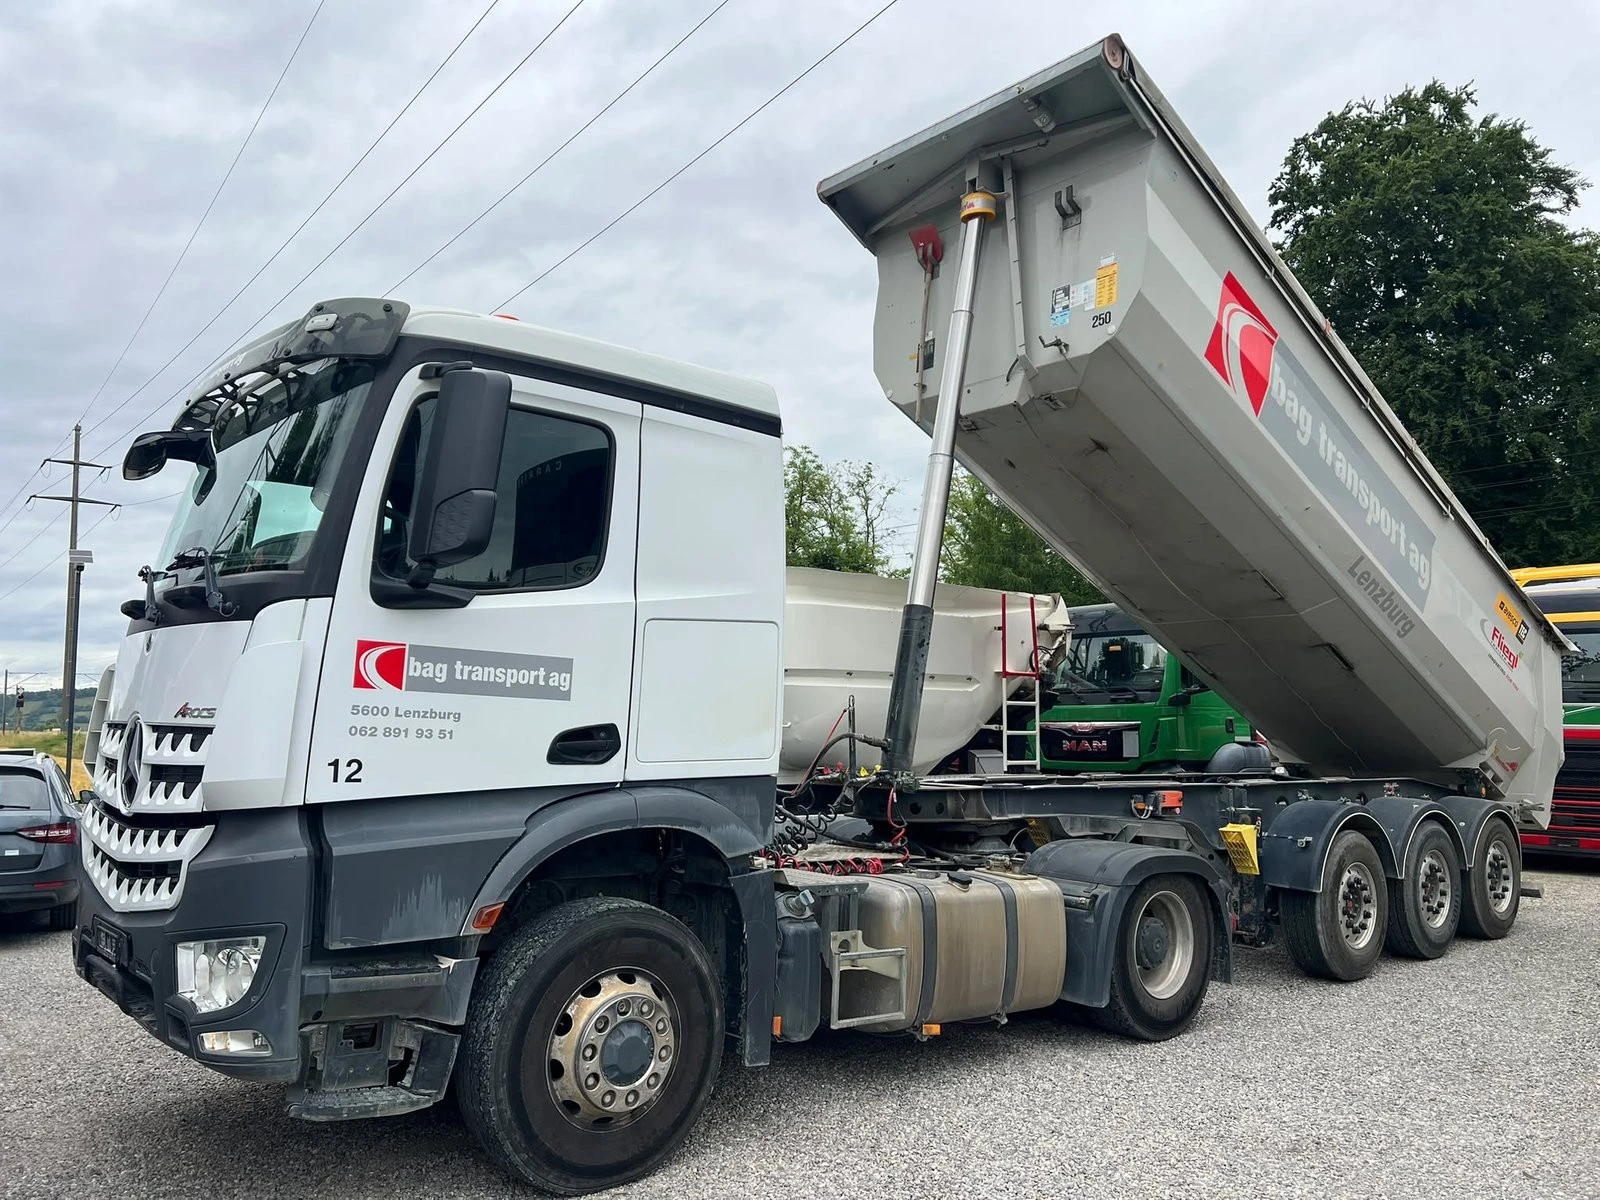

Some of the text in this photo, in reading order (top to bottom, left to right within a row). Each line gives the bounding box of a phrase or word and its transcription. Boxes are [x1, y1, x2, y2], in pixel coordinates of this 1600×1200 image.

[1092, 311, 1111, 328] 250
[1271, 363, 1430, 591] bag transport ag
[1346, 554, 1416, 639] Lenzburg
[1503, 606, 1519, 629] avesco
[1491, 626, 1519, 670] Fliegl
[408, 657, 571, 691] bag transport ag
[350, 704, 462, 723] 5600 Lenzburg
[348, 725, 454, 740] 062 891 93 51
[1062, 739, 1107, 752] MAN
[327, 759, 363, 784] 12
